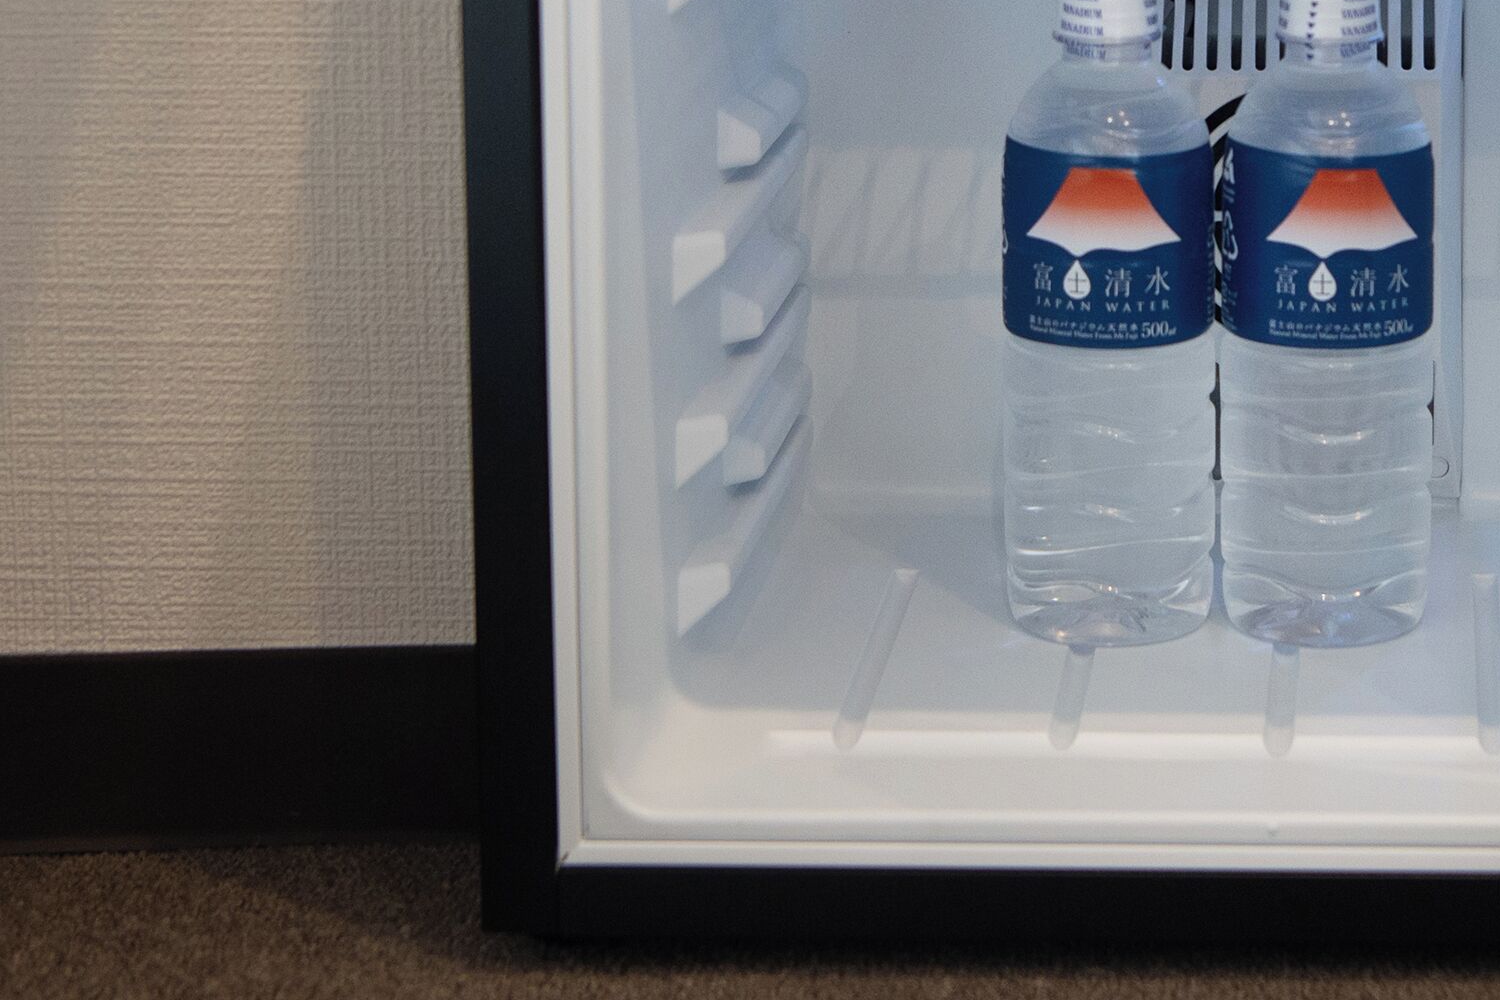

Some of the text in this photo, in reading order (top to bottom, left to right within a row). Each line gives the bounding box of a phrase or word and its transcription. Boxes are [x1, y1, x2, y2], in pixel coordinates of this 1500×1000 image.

[1033, 261, 1171, 298] 富士清水
[1274, 264, 1409, 298] 富士清水
[1036, 296, 1170, 313] JAPAN WATER
[1277, 296, 1409, 313] JAPAN WATER
